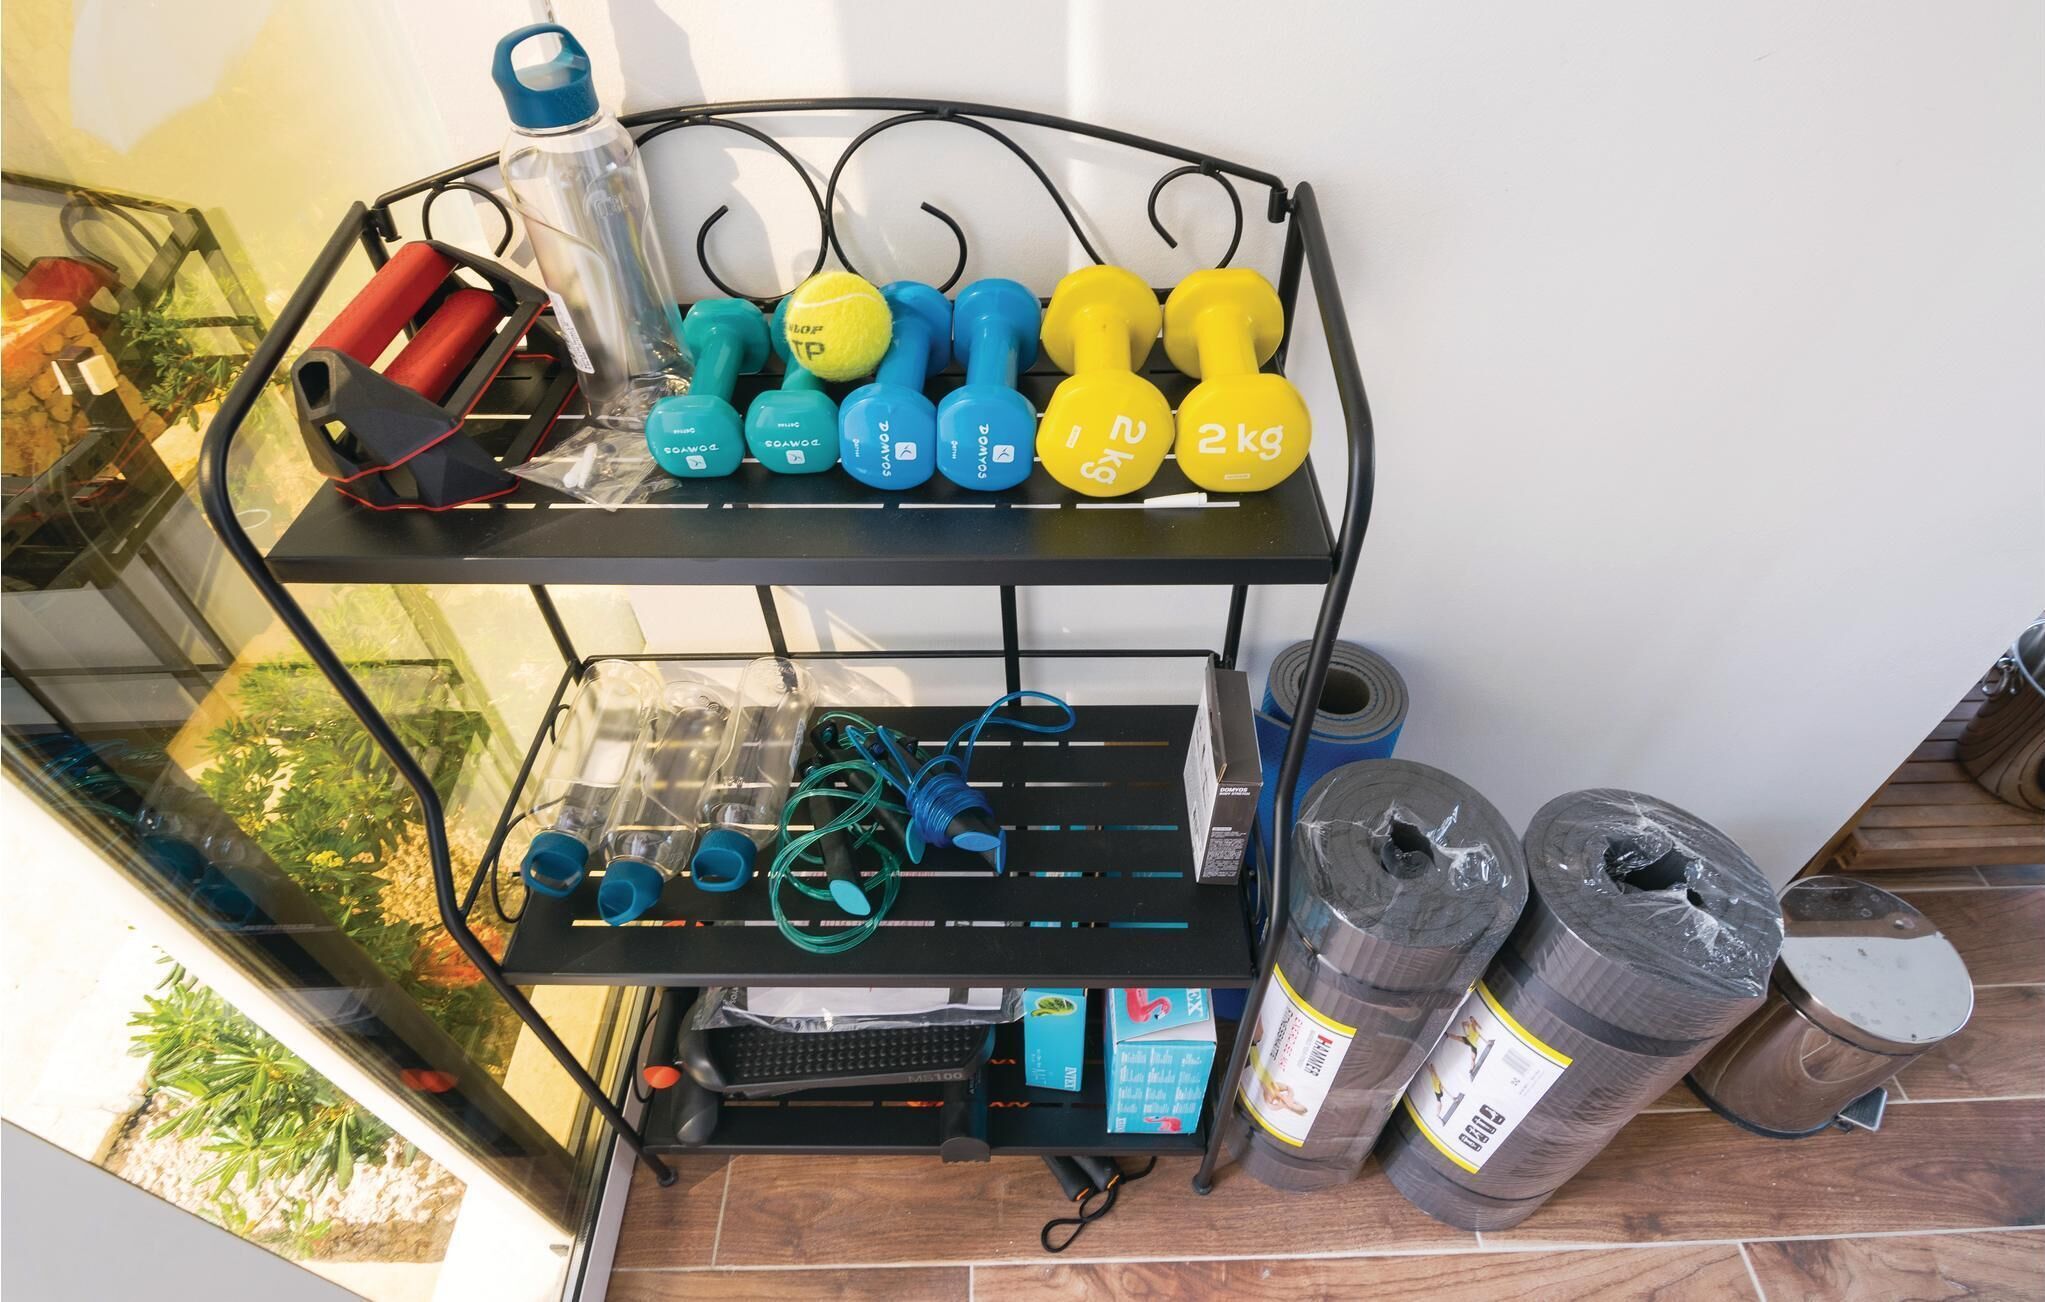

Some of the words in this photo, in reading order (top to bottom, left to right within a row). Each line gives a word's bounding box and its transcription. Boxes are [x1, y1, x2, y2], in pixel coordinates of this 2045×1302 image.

[664, 443, 720, 454] DOMYOS
[765, 439, 821, 448] DOMYOS
[1109, 414, 1147, 445] 2
[1198, 423, 1227, 454] 2
[1237, 423, 1284, 461] kg
[878, 420, 892, 478] DOMYOS
[977, 423, 990, 480] DOMYOS
[1080, 447, 1135, 485] kg
[1304, 1033, 1334, 1077] HAMMER
